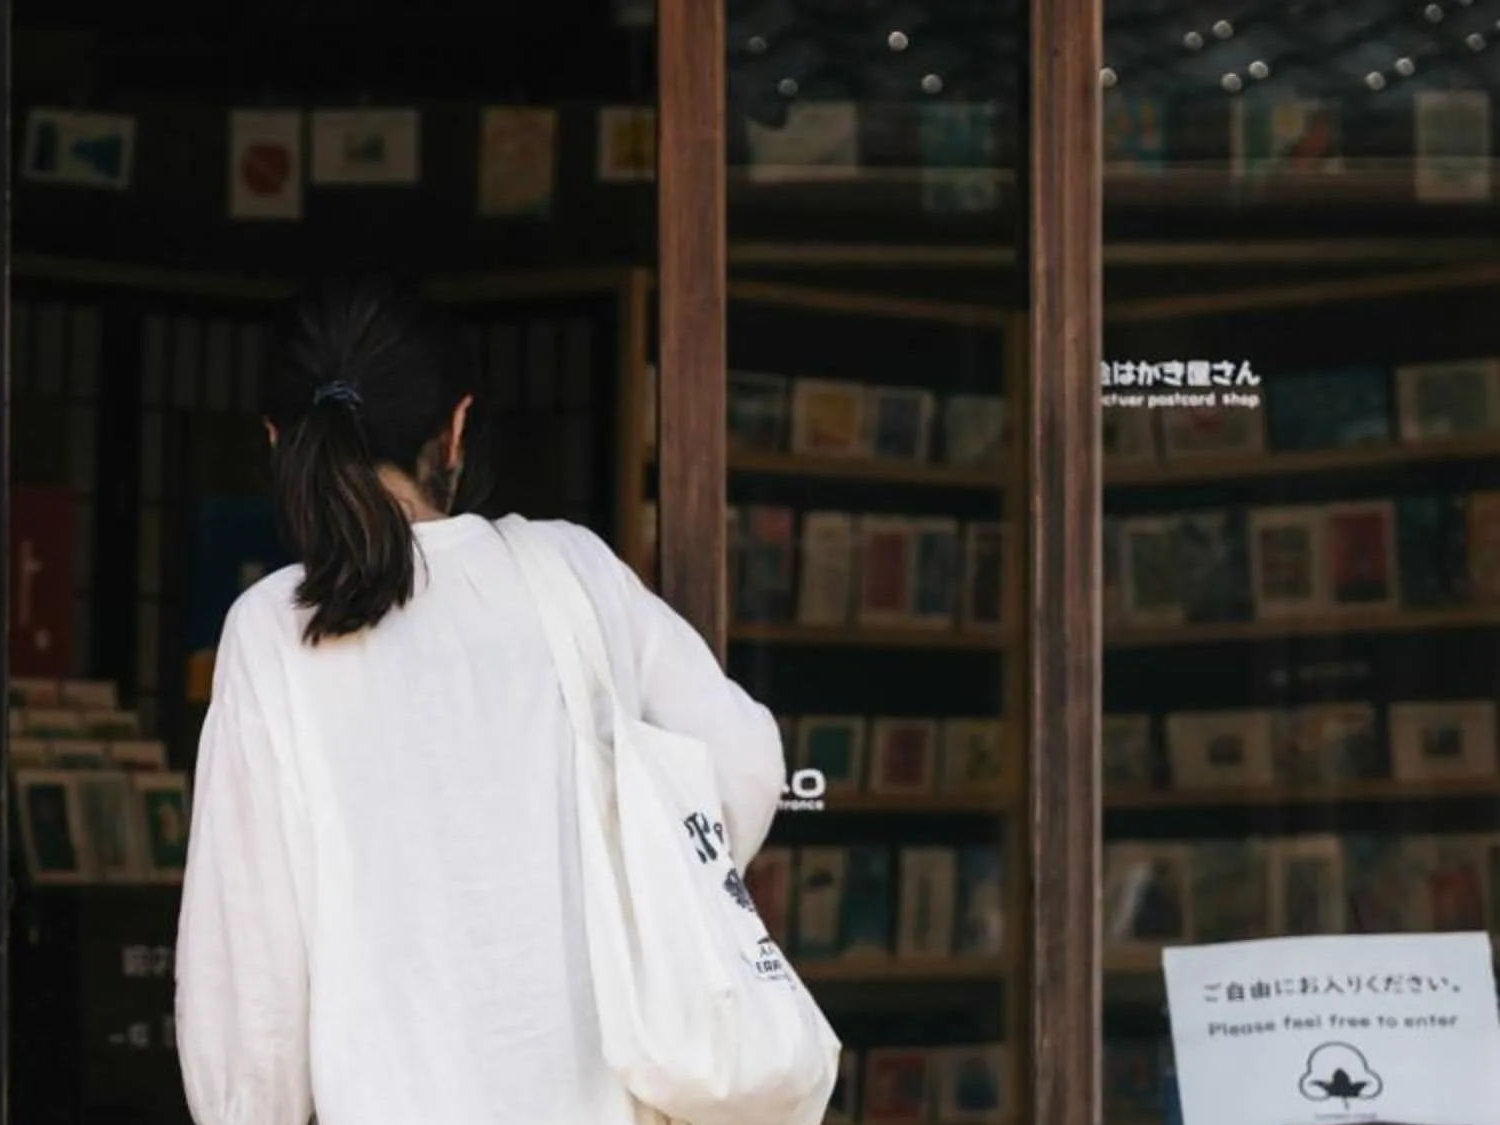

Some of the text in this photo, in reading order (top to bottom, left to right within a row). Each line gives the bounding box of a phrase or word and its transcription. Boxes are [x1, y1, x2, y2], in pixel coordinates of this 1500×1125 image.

[1223, 393, 1260, 408] shop
[1203, 974, 1460, 1002] ご自由にお入りください。
[1207, 1013, 1458, 1037] Please feel free to enter
